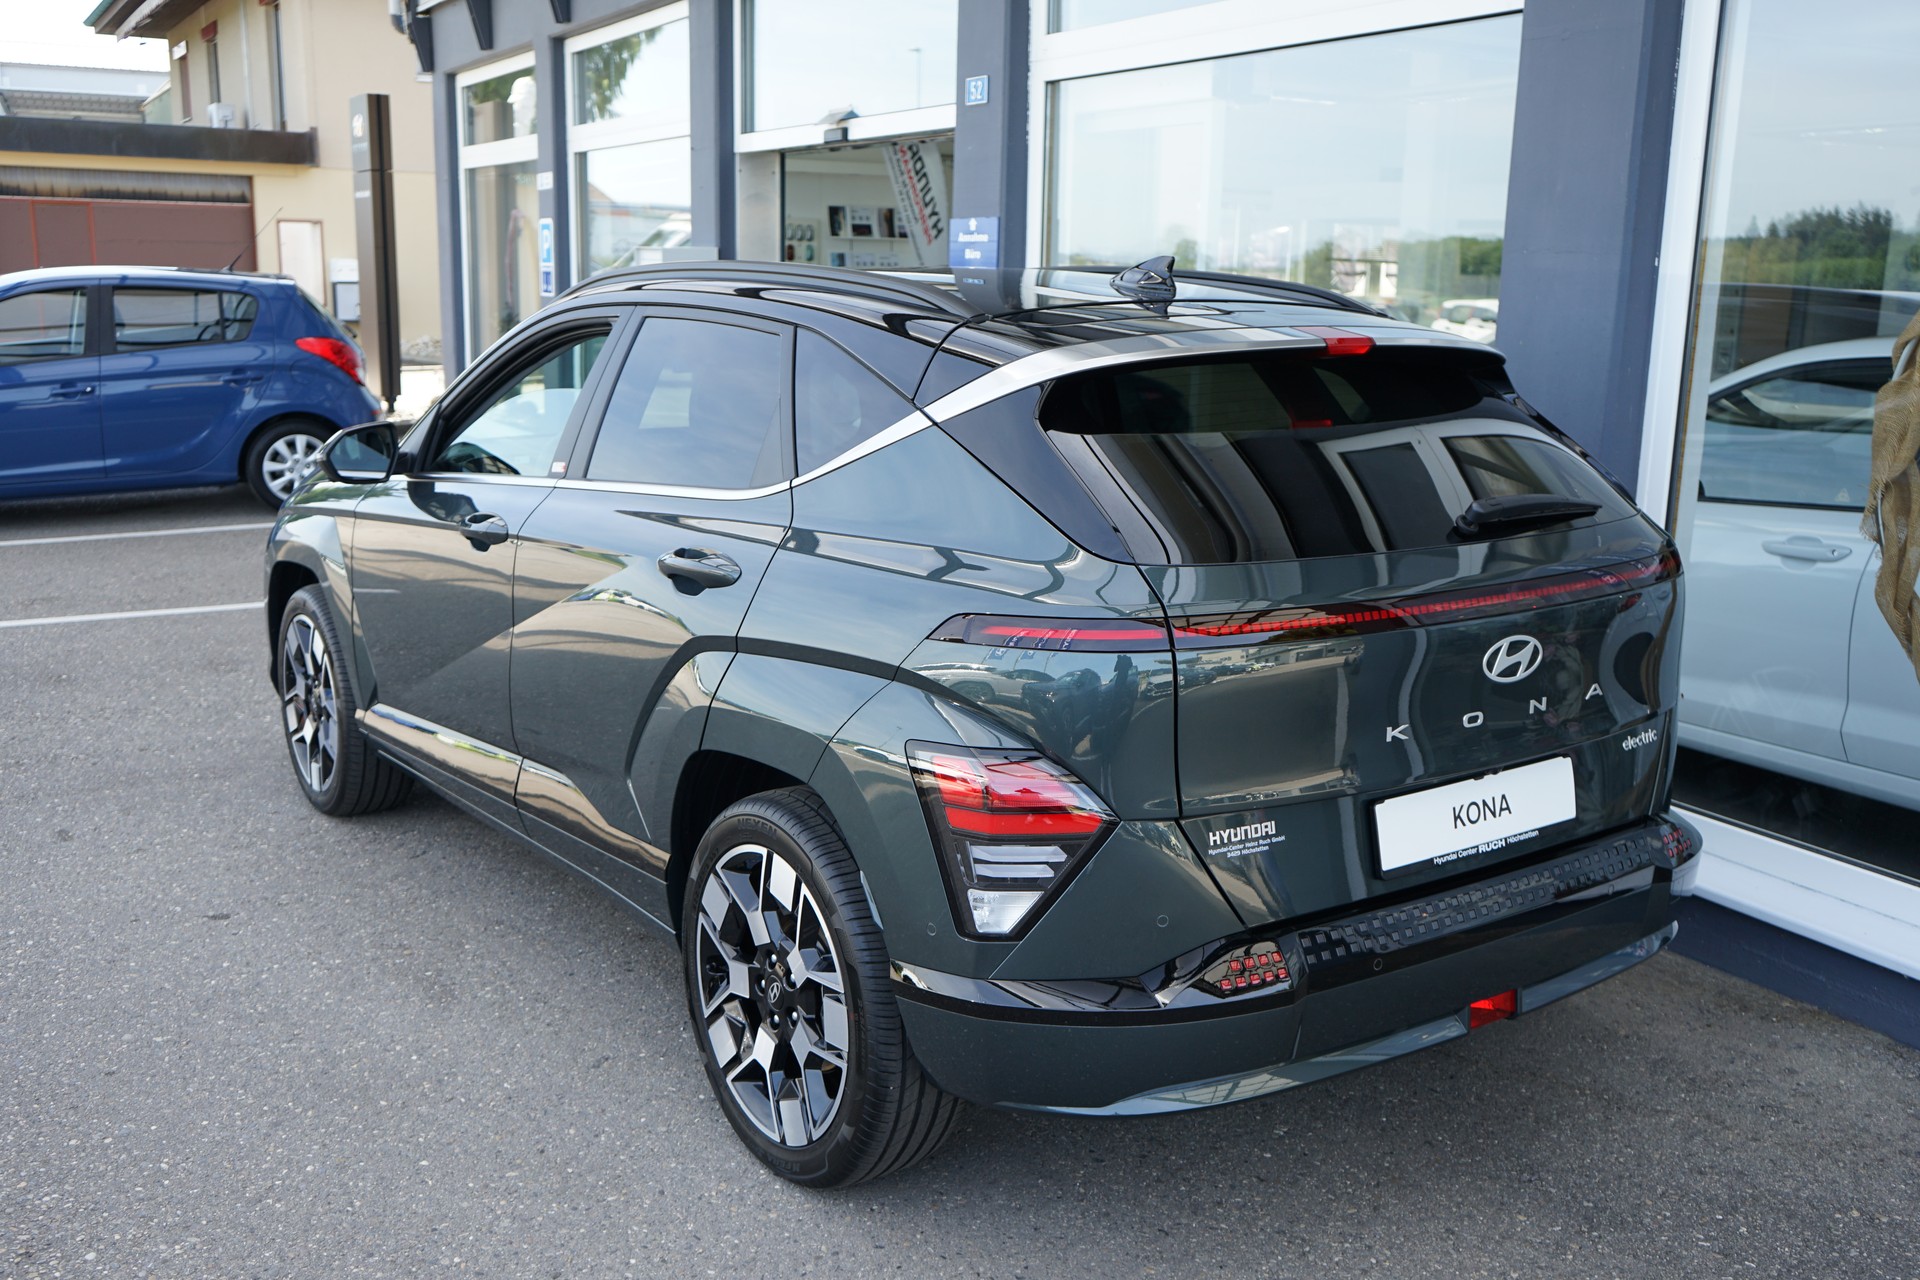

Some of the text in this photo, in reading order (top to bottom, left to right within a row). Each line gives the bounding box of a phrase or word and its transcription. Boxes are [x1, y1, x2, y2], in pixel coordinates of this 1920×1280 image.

[970, 80, 983, 100] 52
[1622, 729, 1657, 751] electric
[1452, 794, 1512, 829] KONA
[737, 818, 779, 840] NEXEN
[1208, 821, 1276, 846] HYUNDAI
[1433, 830, 1539, 865] Hyundai Center RUCH Höchstetten
